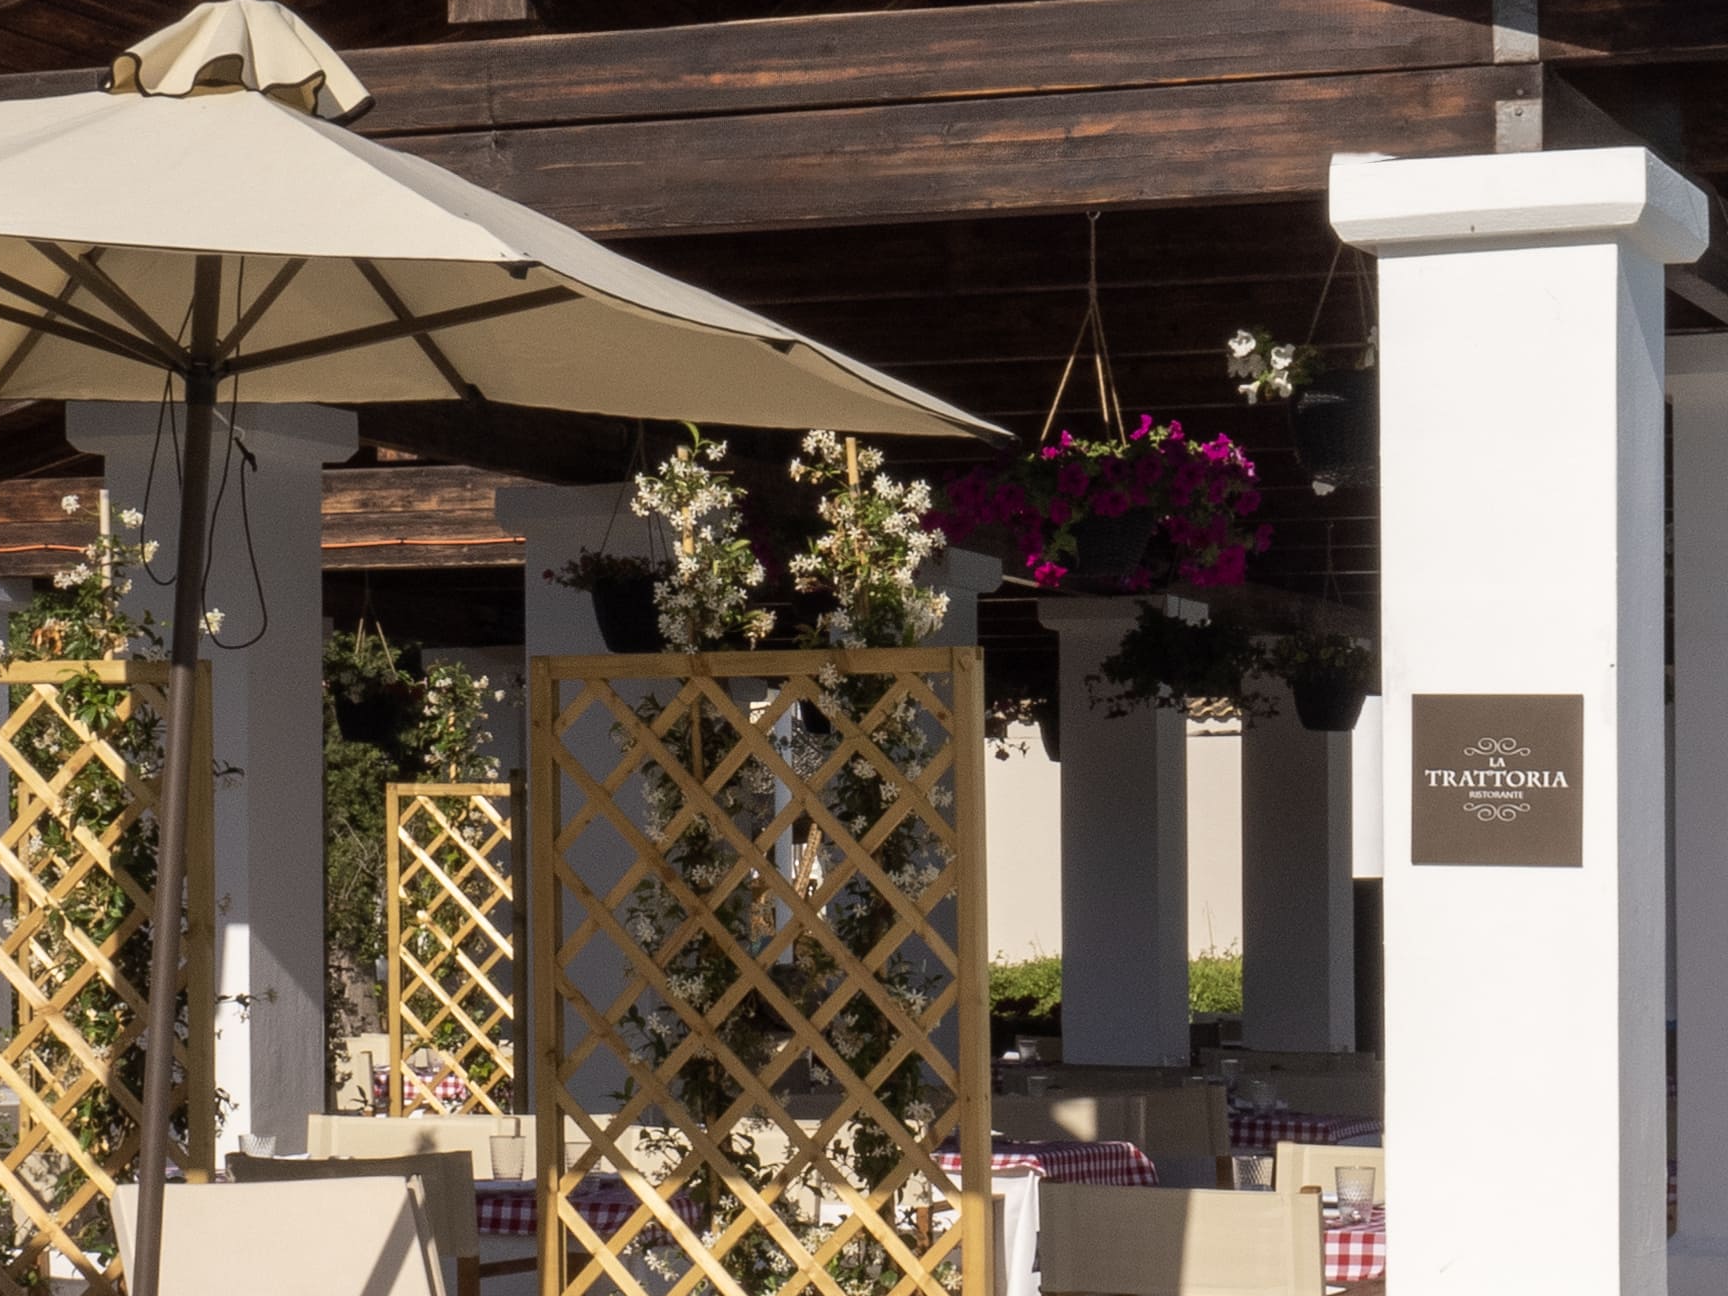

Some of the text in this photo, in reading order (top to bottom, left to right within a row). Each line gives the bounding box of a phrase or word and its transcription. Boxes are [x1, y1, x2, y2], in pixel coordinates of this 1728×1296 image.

[1489, 757, 1506, 767] LA
[1425, 769, 1568, 788] TRATTORIA
[1469, 791, 1523, 799] RISTORANTE
